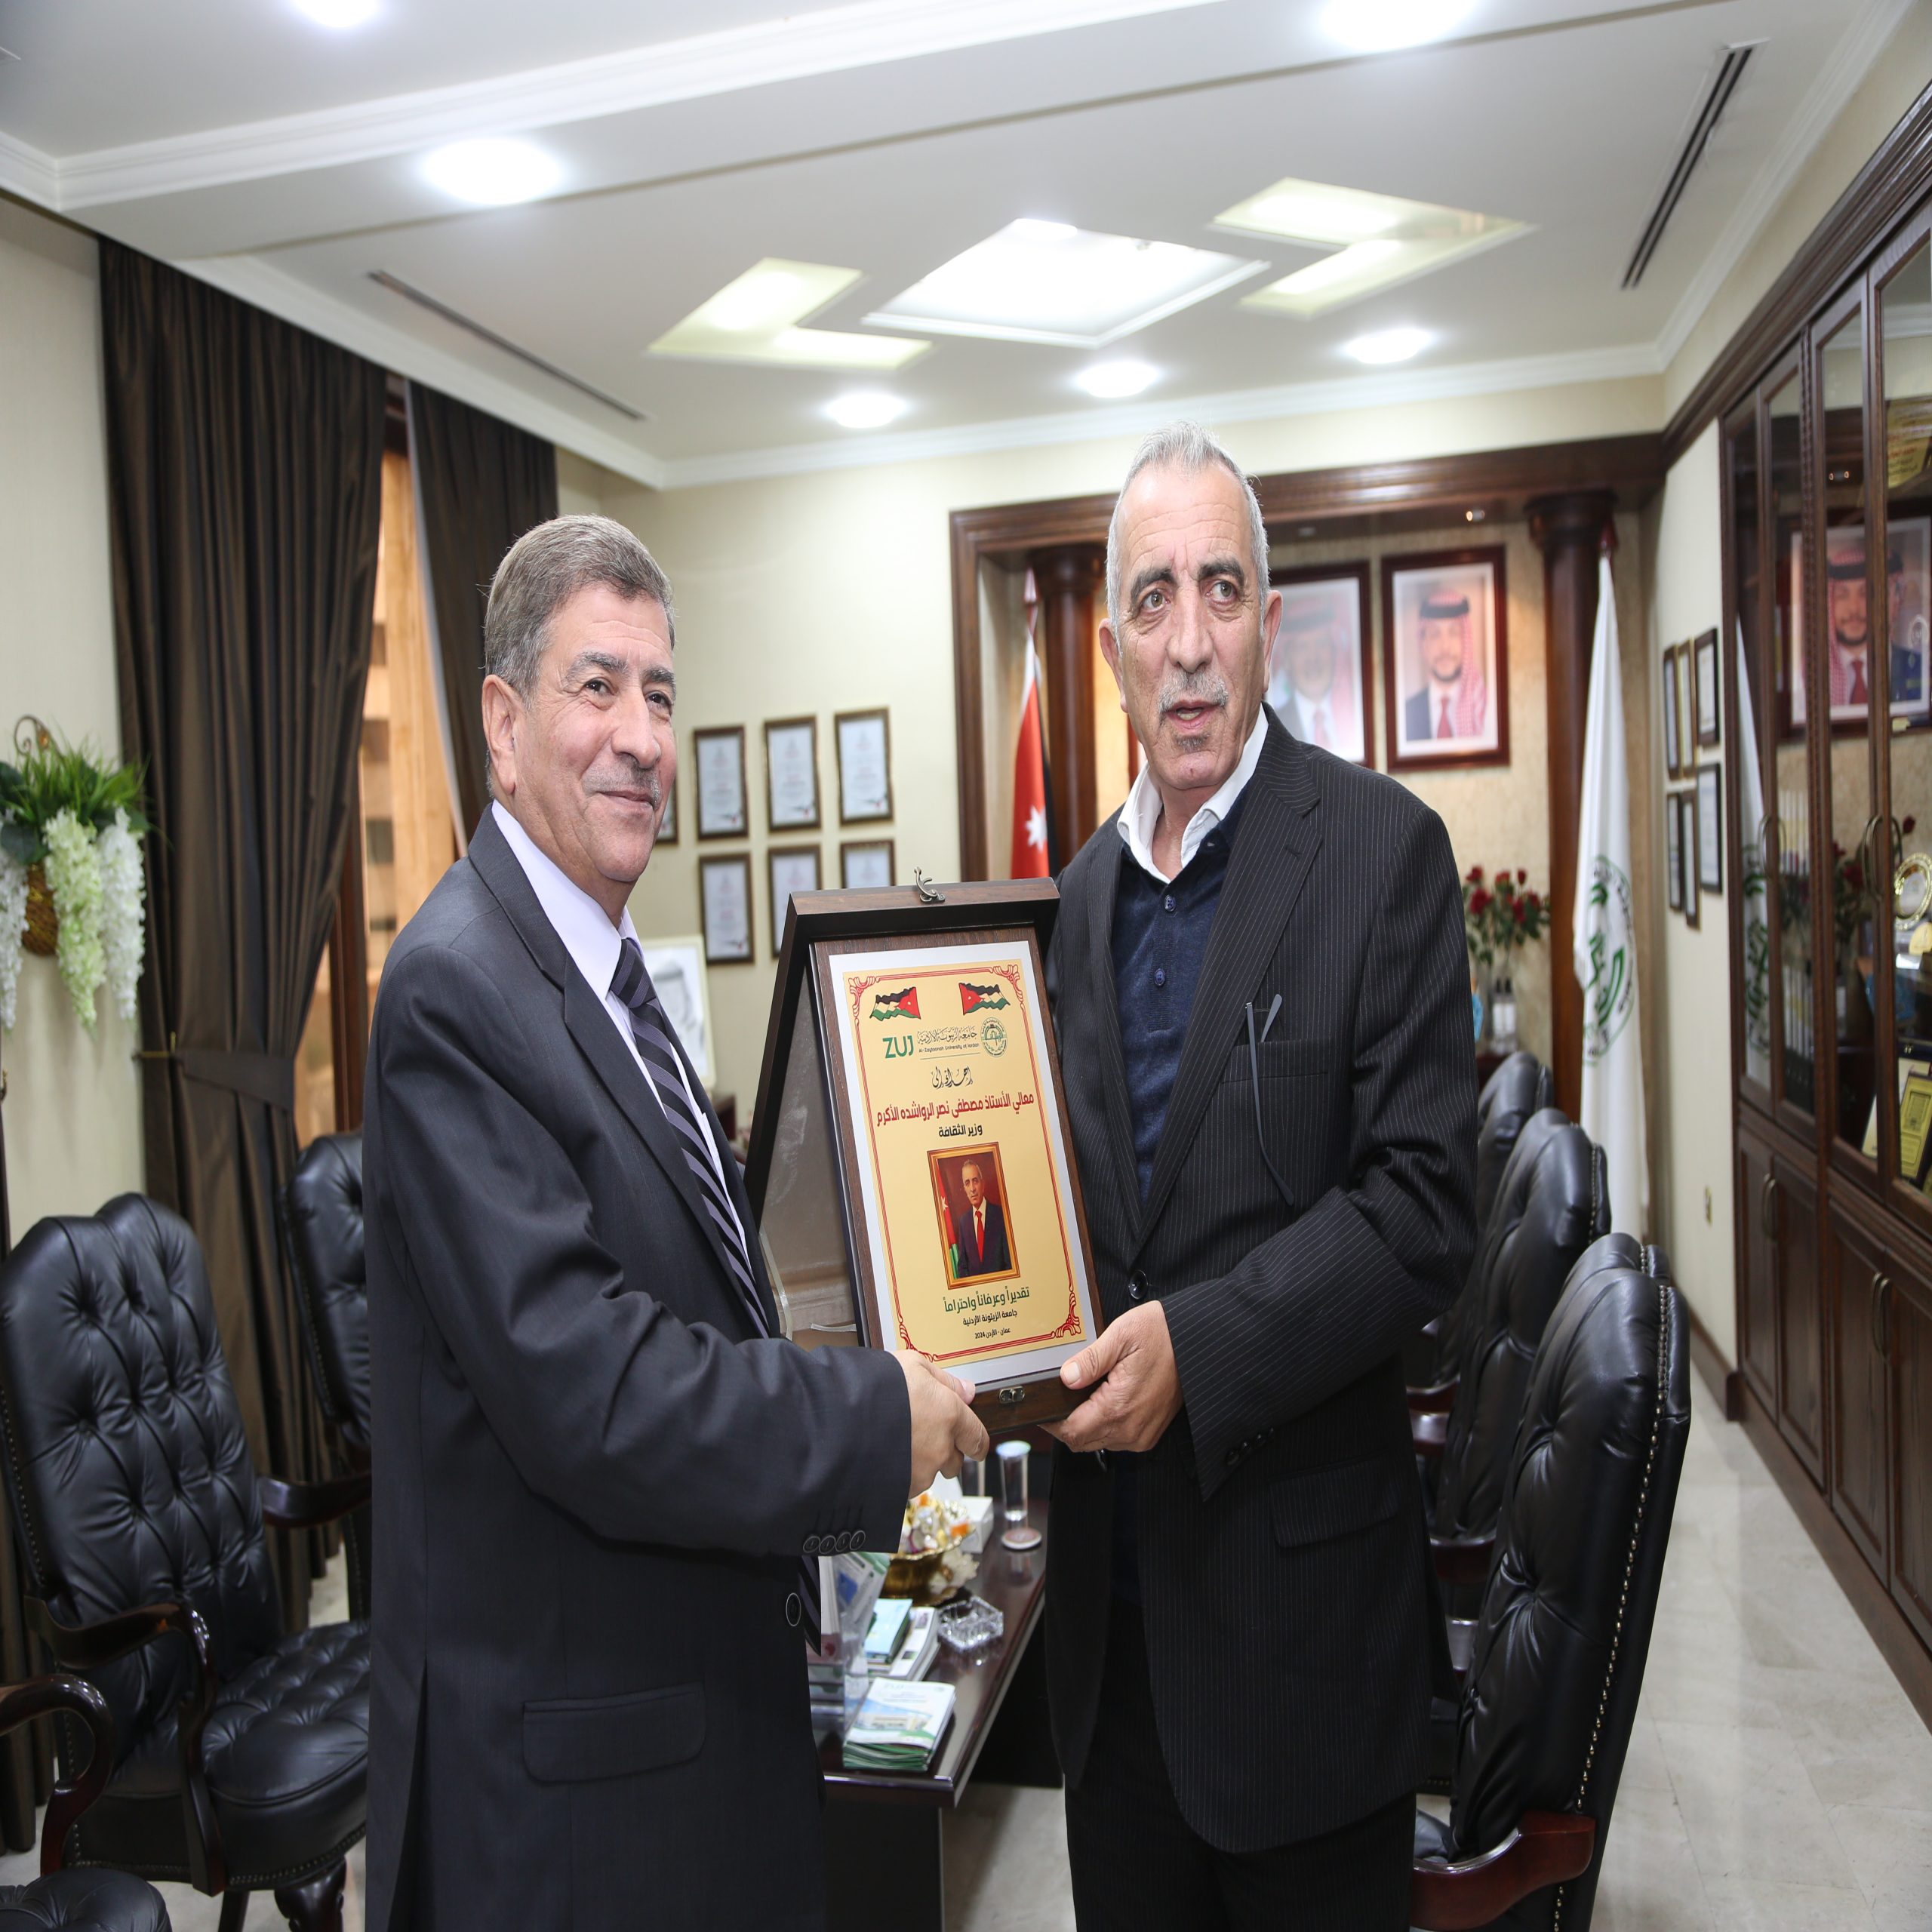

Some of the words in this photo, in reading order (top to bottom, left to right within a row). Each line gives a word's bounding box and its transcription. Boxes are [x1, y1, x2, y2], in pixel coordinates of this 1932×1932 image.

[882, 1035, 914, 1058] ZUJ
[985, 1091, 1011, 1109] الأستاذ
[1012, 1091, 1034, 1115] معالي
[876, 1103, 900, 1127] الأكرم
[936, 1100, 949, 1119] نصر
[951, 1098, 983, 1118] مصطفى
[938, 1123, 966, 1137] الثقافة
[968, 1124, 983, 1137] وزير
[982, 1312, 1001, 1323] الزيتونة
[1001, 1309, 1017, 1318] جامعة
[963, 1315, 981, 1327] الأردنية
[986, 1329, 998, 1338] الأردن
[1000, 1327, 1011, 1336] عمان
